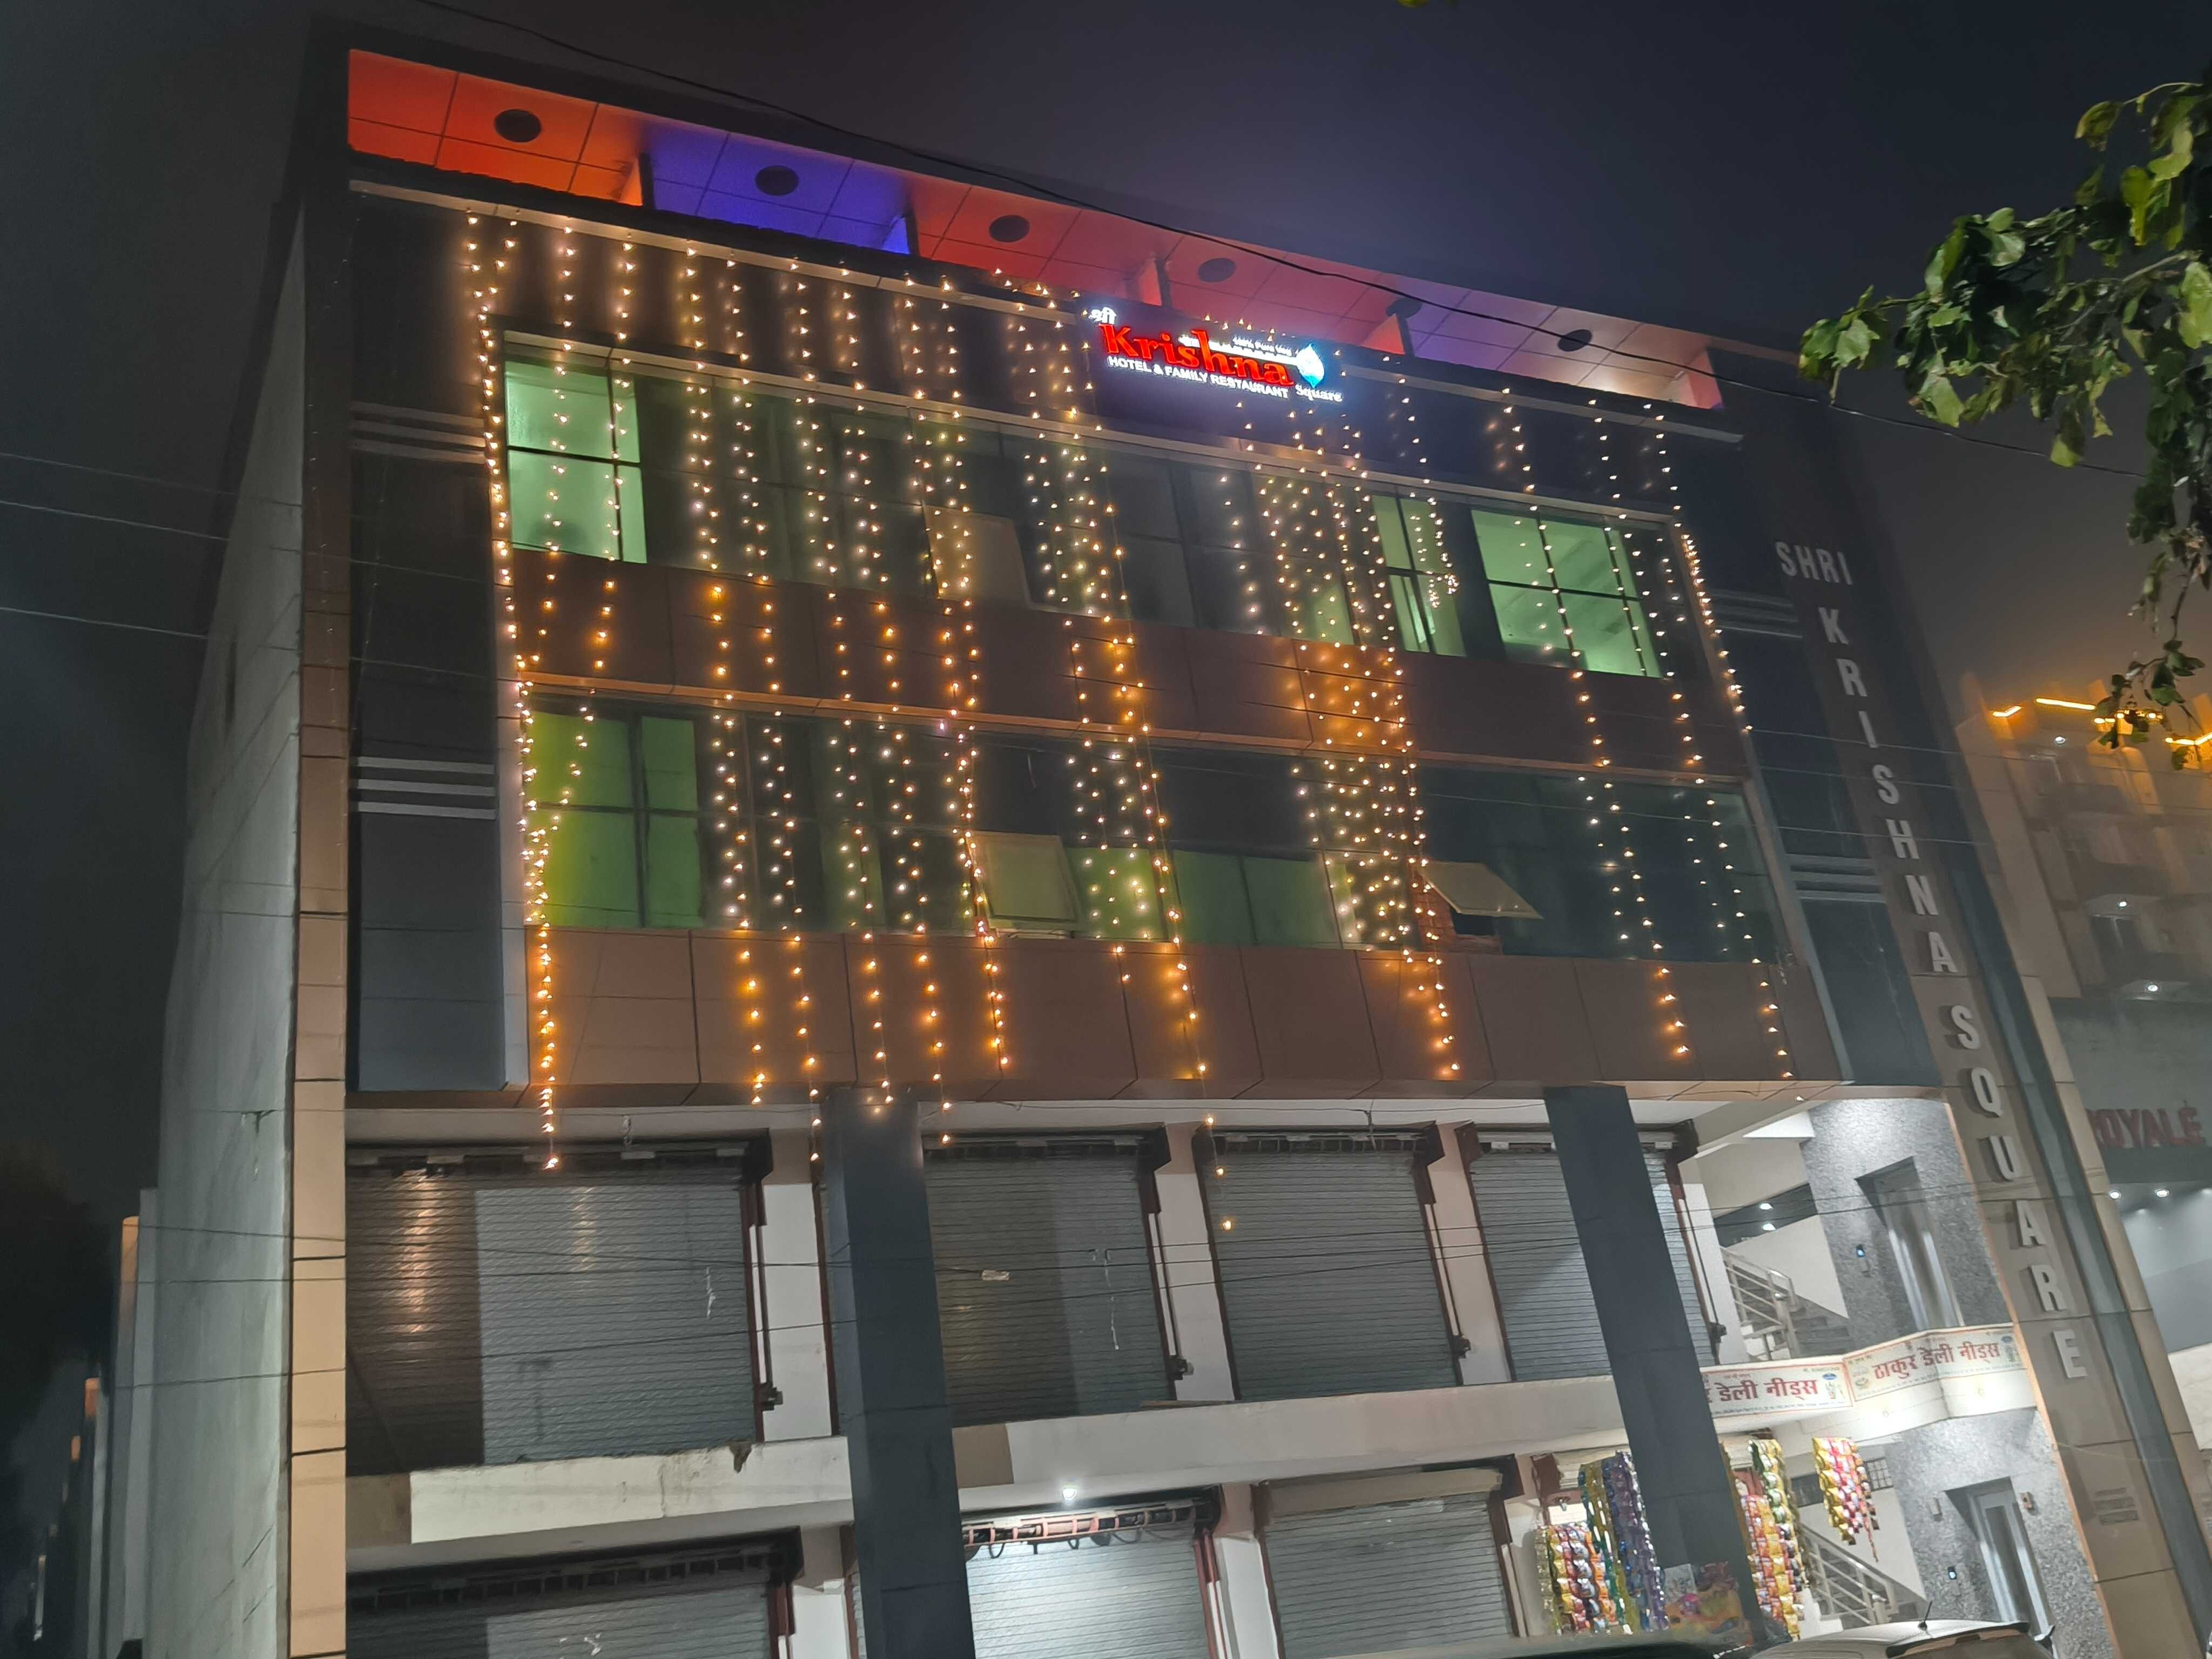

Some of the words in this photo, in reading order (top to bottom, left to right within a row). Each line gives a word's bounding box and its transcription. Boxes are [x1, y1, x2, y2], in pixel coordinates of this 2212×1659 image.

[1088, 307, 1117, 325] श्री
[1098, 323, 1294, 386] Krishna
[1108, 356, 1152, 373] HOTEL
[1153, 363, 1164, 375] &
[1164, 366, 1209, 383] FAMILY
[1210, 374, 1289, 399] RESTAURANT
[1294, 384, 1343, 402] Square
[1775, 541, 1853, 585] SHRI
[1818, 606, 1959, 973] KRISHNA
[1951, 1004, 2088, 1379] SQUARE
[1872, 1353, 1918, 1379] ठाकुर
[1917, 1343, 1955, 1366] डेली
[1957, 1341, 2001, 1364] नीड्स
[1714, 1380, 1758, 1401] डेली
[1763, 1378, 1819, 1400] नीड्स
